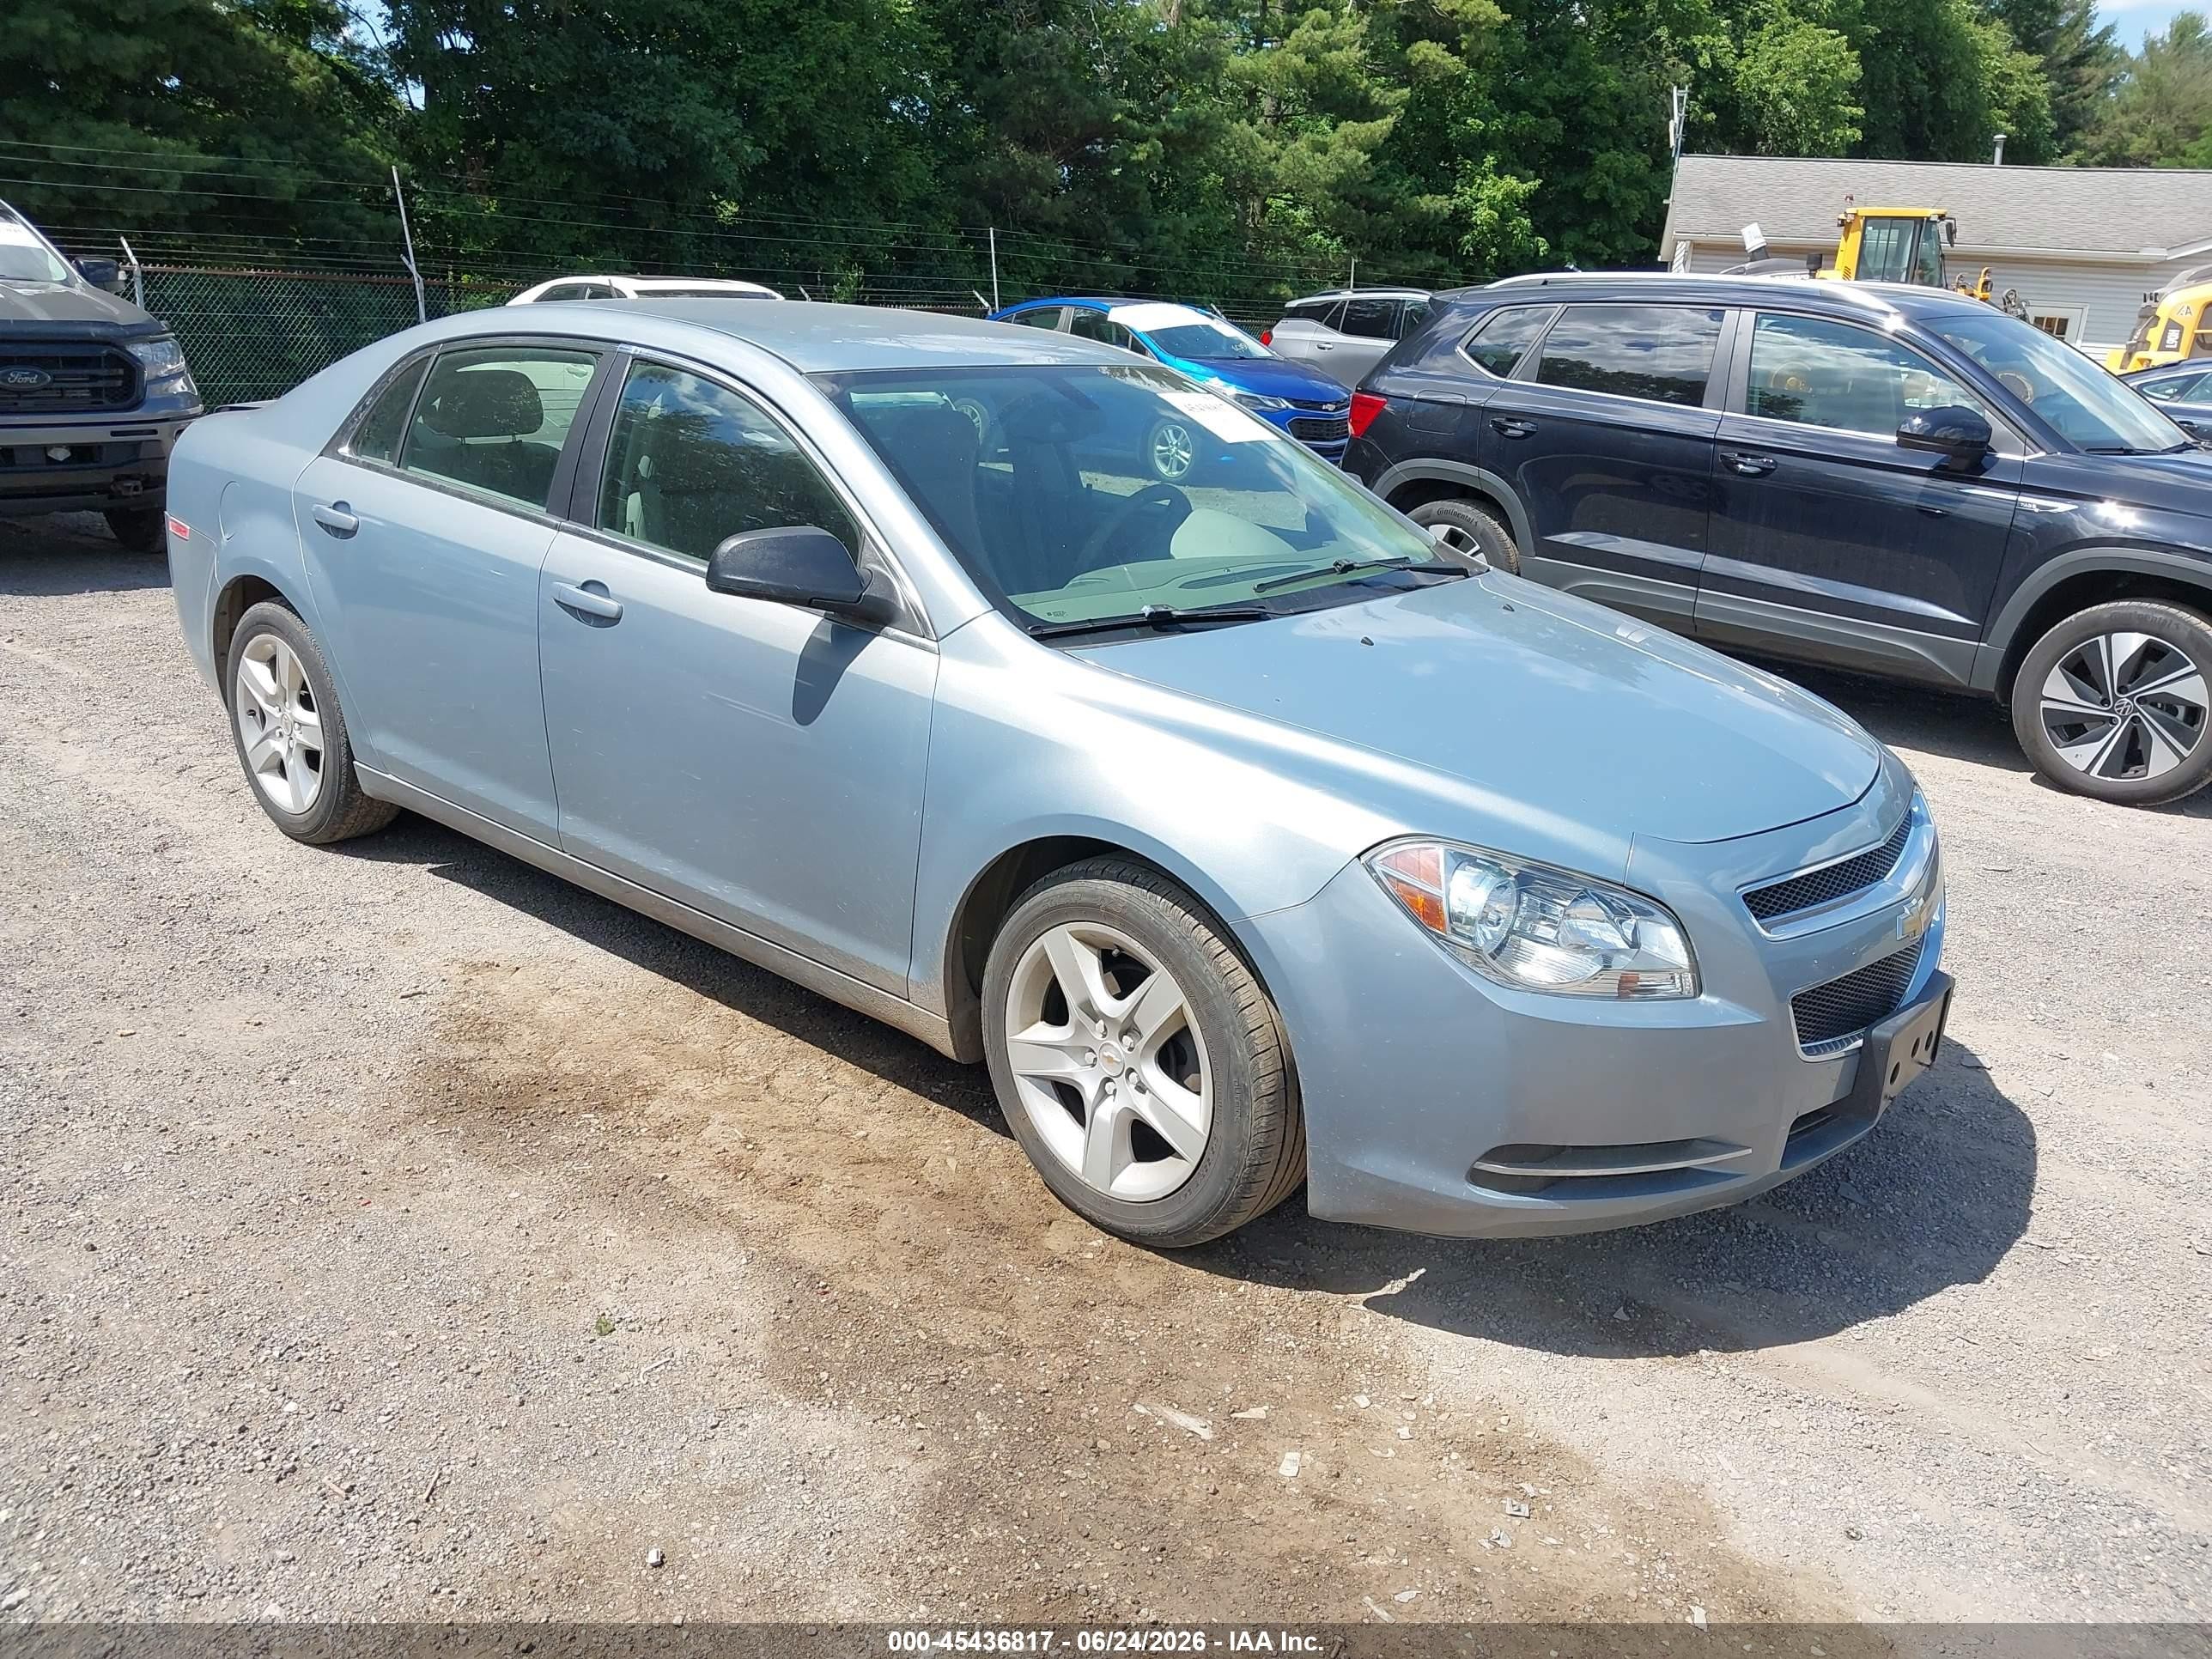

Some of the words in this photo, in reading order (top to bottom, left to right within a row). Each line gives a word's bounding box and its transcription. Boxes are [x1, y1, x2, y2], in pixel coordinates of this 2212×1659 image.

[2165, 329, 2180, 349] L90H
[8, 370, 39, 384] Ford
[1437, 507, 1474, 525] Continental
